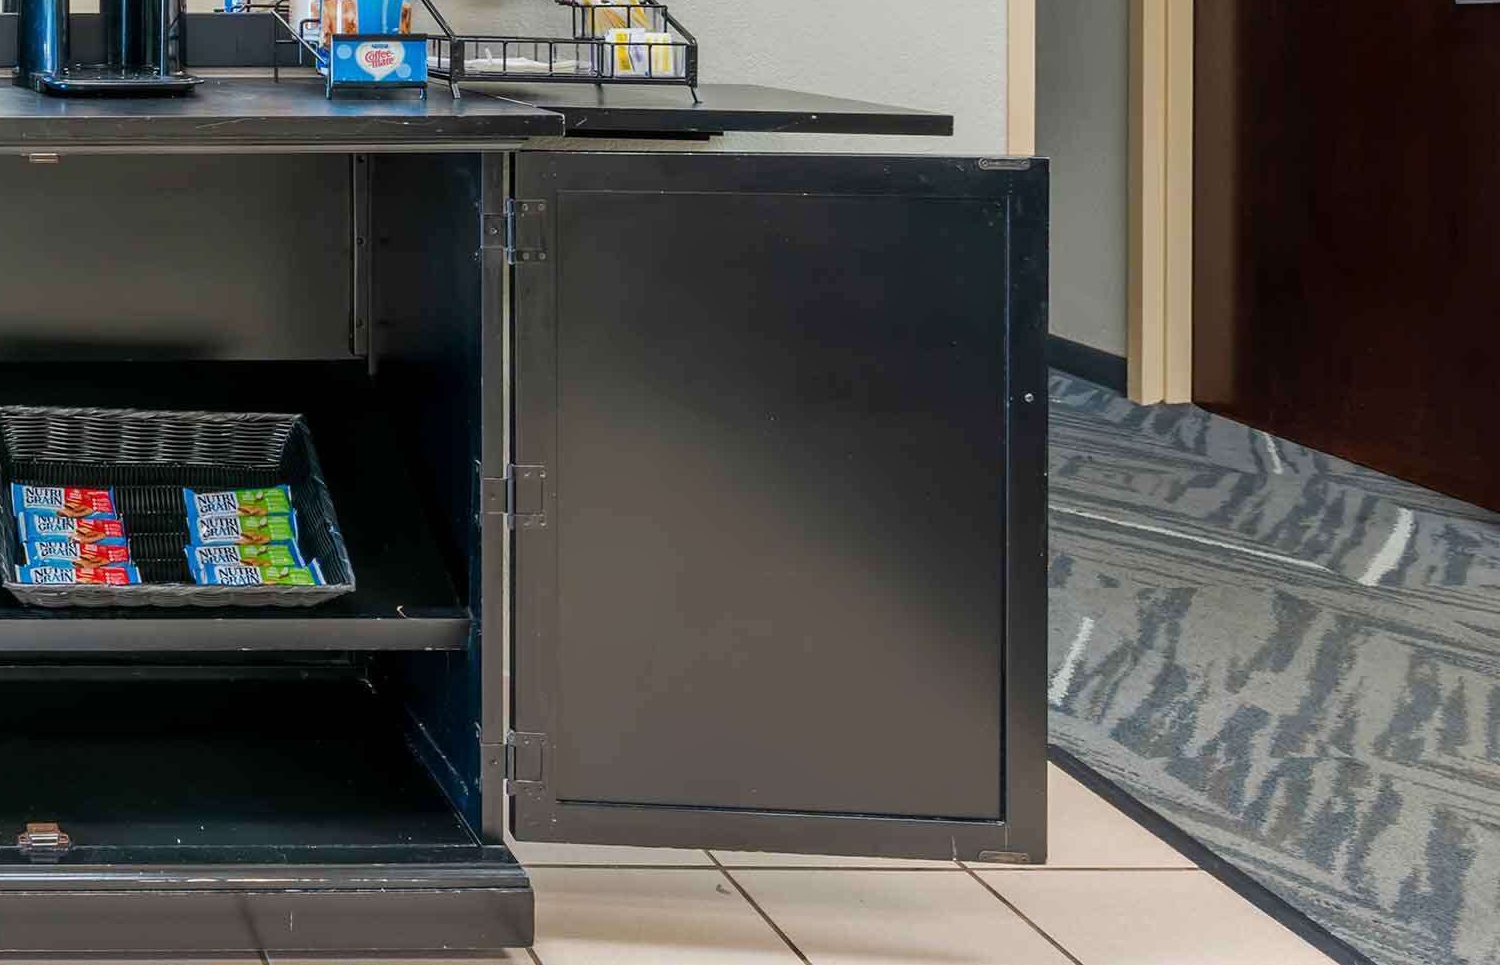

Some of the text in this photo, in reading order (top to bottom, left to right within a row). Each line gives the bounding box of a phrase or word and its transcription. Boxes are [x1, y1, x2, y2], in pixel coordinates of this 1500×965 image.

[372, 56, 395, 68] mate
[25, 488, 61, 497] NUTRI
[26, 495, 63, 506] GRAIN
[197, 494, 235, 505] NUTRI
[200, 502, 238, 514] GRAIN
[38, 521, 75, 531] GRAIN
[201, 517, 238, 528] NUTRI
[203, 525, 240, 538] GRAIN
[41, 547, 78, 557] GRAIN
[199, 547, 237, 557] NUTRI
[219, 566, 258, 577] NUTRI
[35, 574, 74, 585] GRAIN
[221, 575, 260, 586] GRAIN
